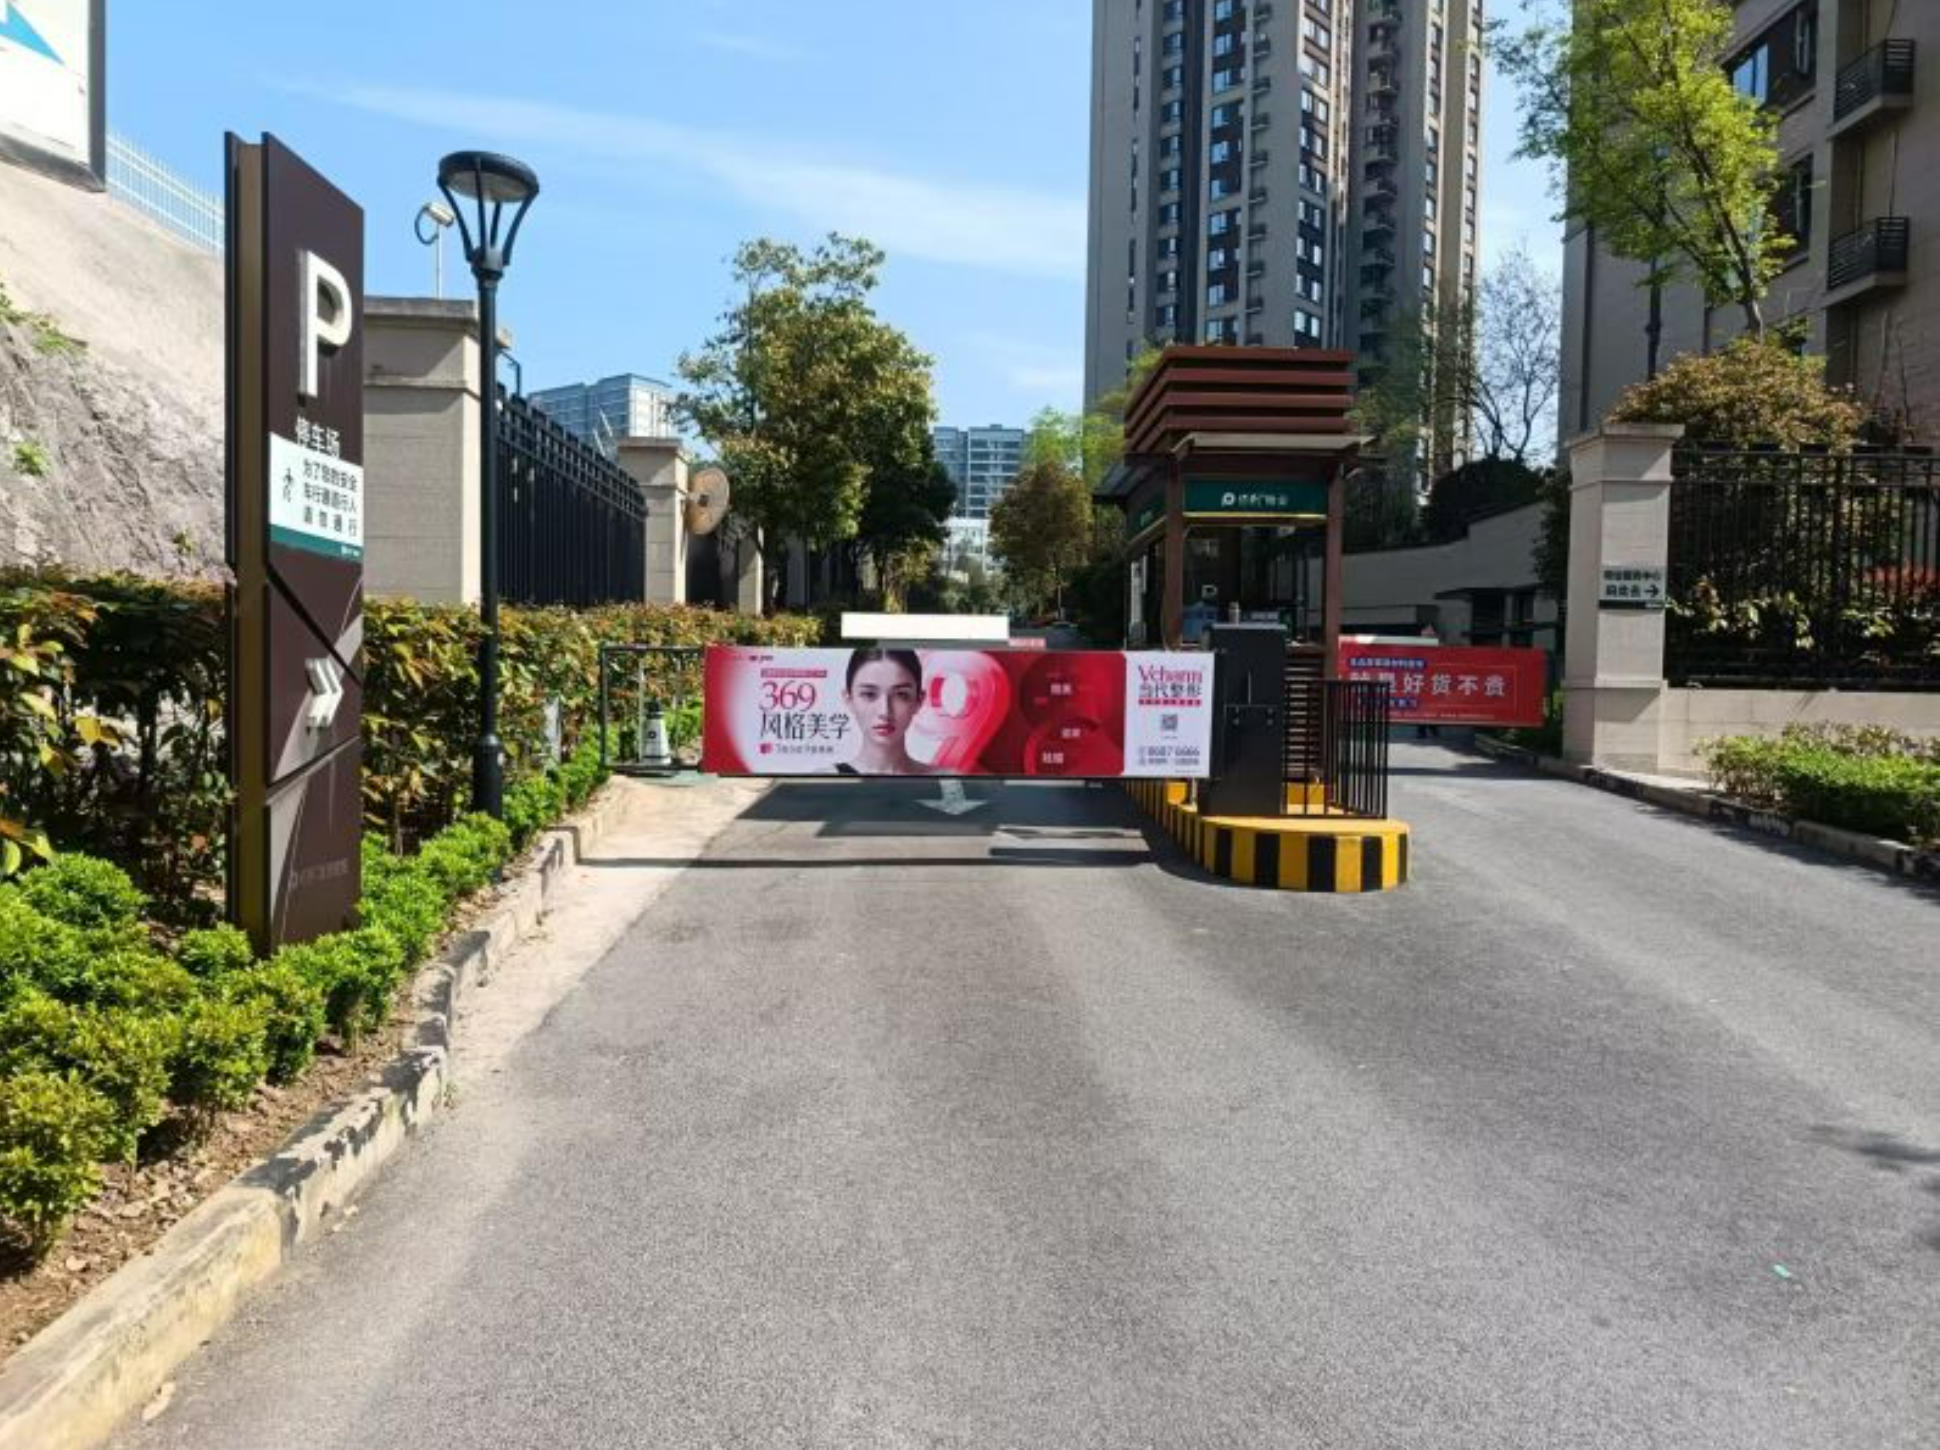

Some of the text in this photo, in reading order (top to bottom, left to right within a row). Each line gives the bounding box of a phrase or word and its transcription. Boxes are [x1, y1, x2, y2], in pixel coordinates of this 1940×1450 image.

[298, 250, 352, 398] P
[759, 680, 816, 712] 369
[759, 712, 851, 740] 风格美学
